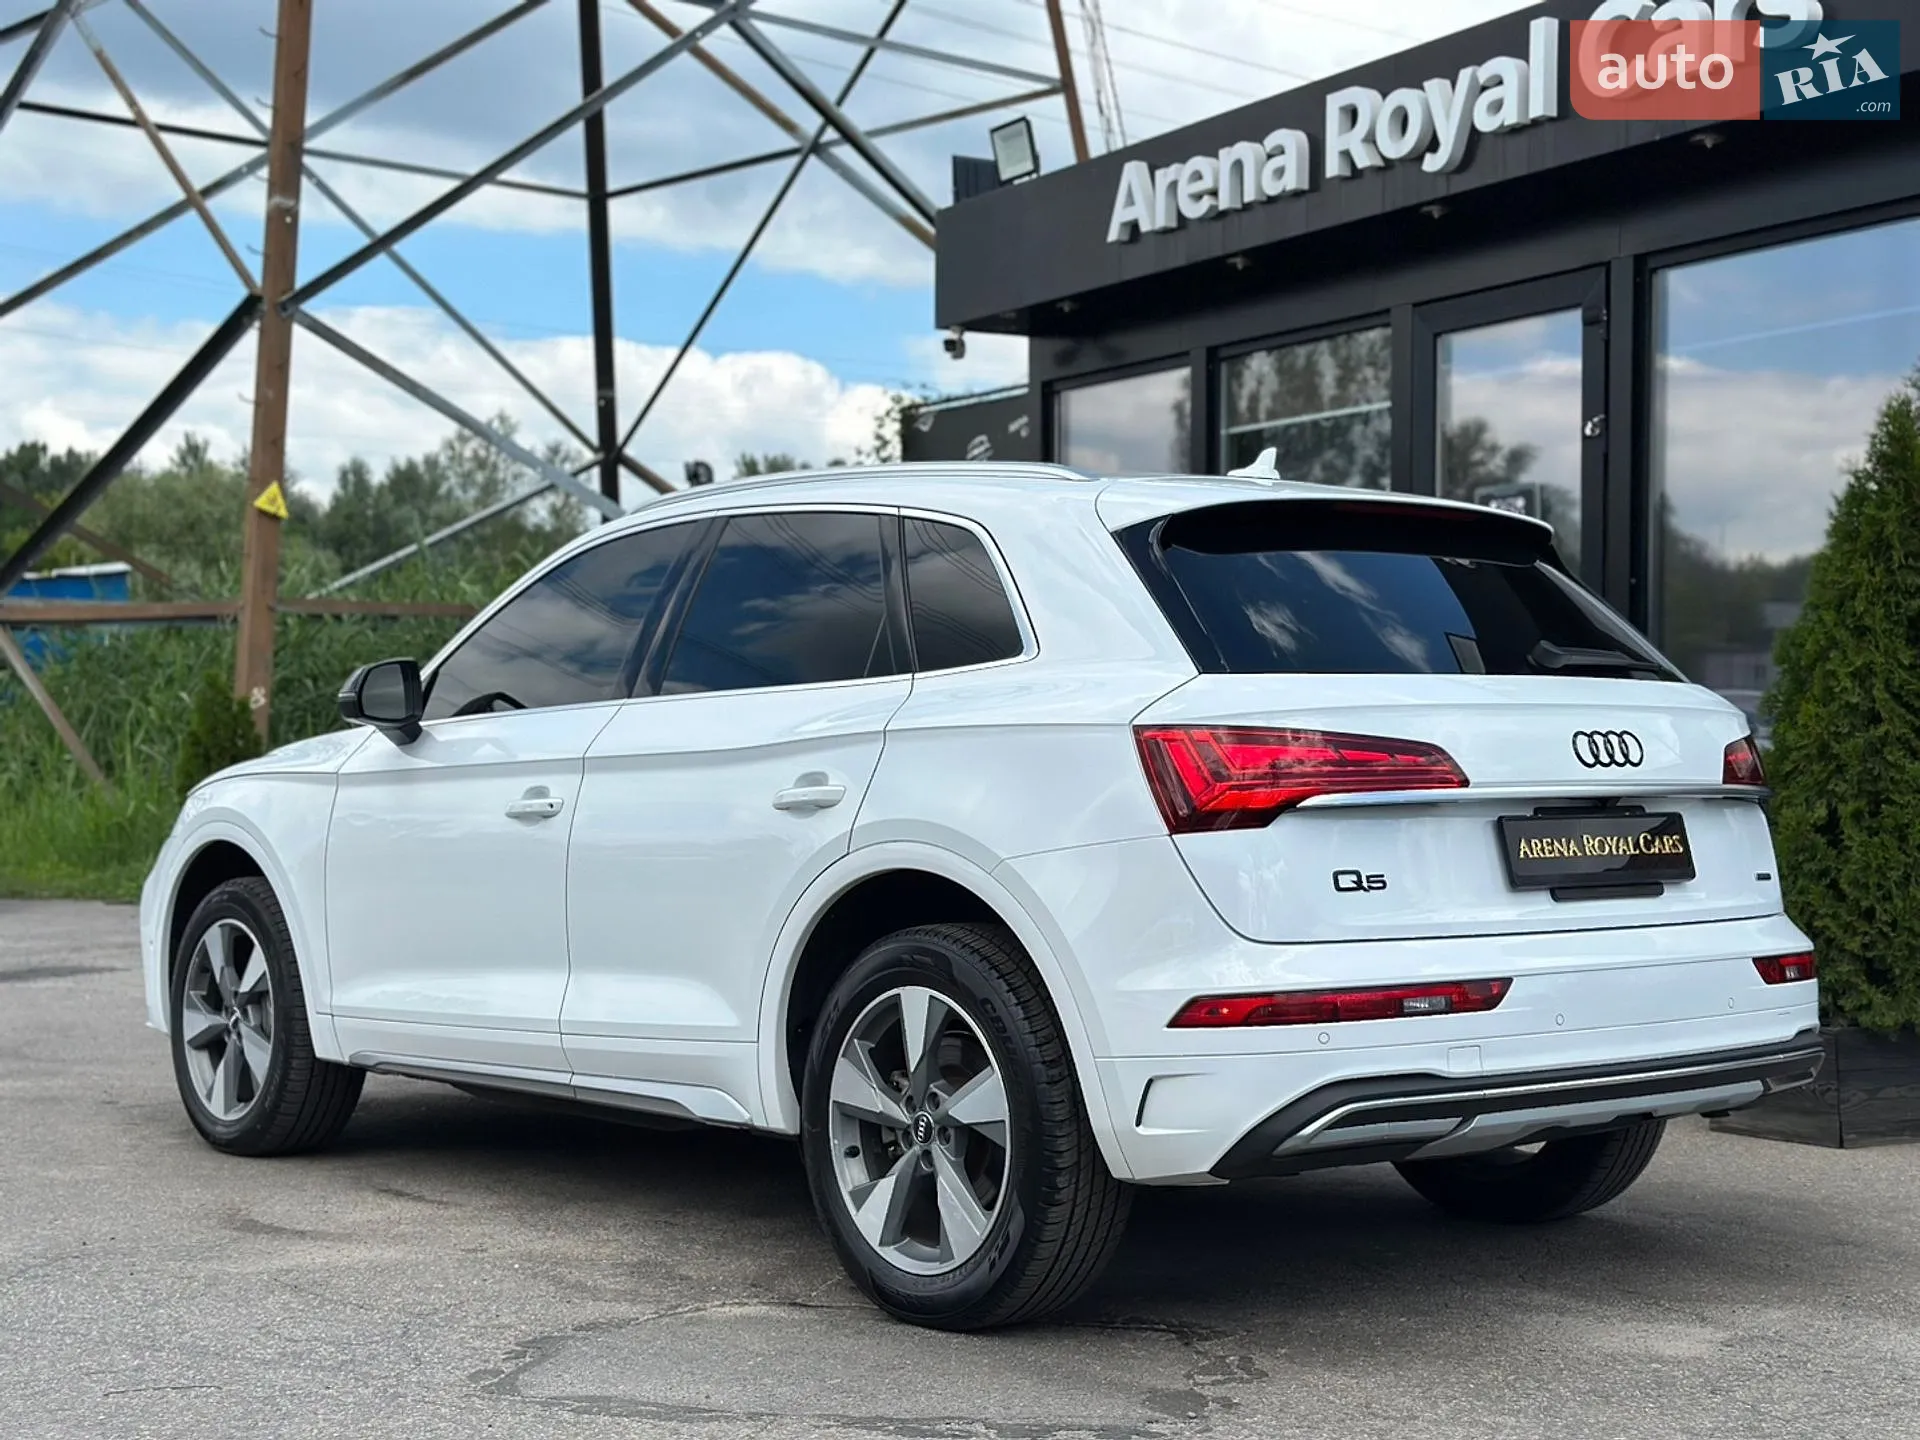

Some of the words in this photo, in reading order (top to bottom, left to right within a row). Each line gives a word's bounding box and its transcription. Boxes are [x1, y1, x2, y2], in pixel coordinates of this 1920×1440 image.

[1105, 127, 1310, 244] Arena
[1325, 16, 1559, 179] Royal
[1518, 836, 1582, 859] ARENA
[1583, 833, 1639, 856] ROYAL
[1639, 831, 1684, 855] CARS
[1332, 869, 1388, 893] Q5
